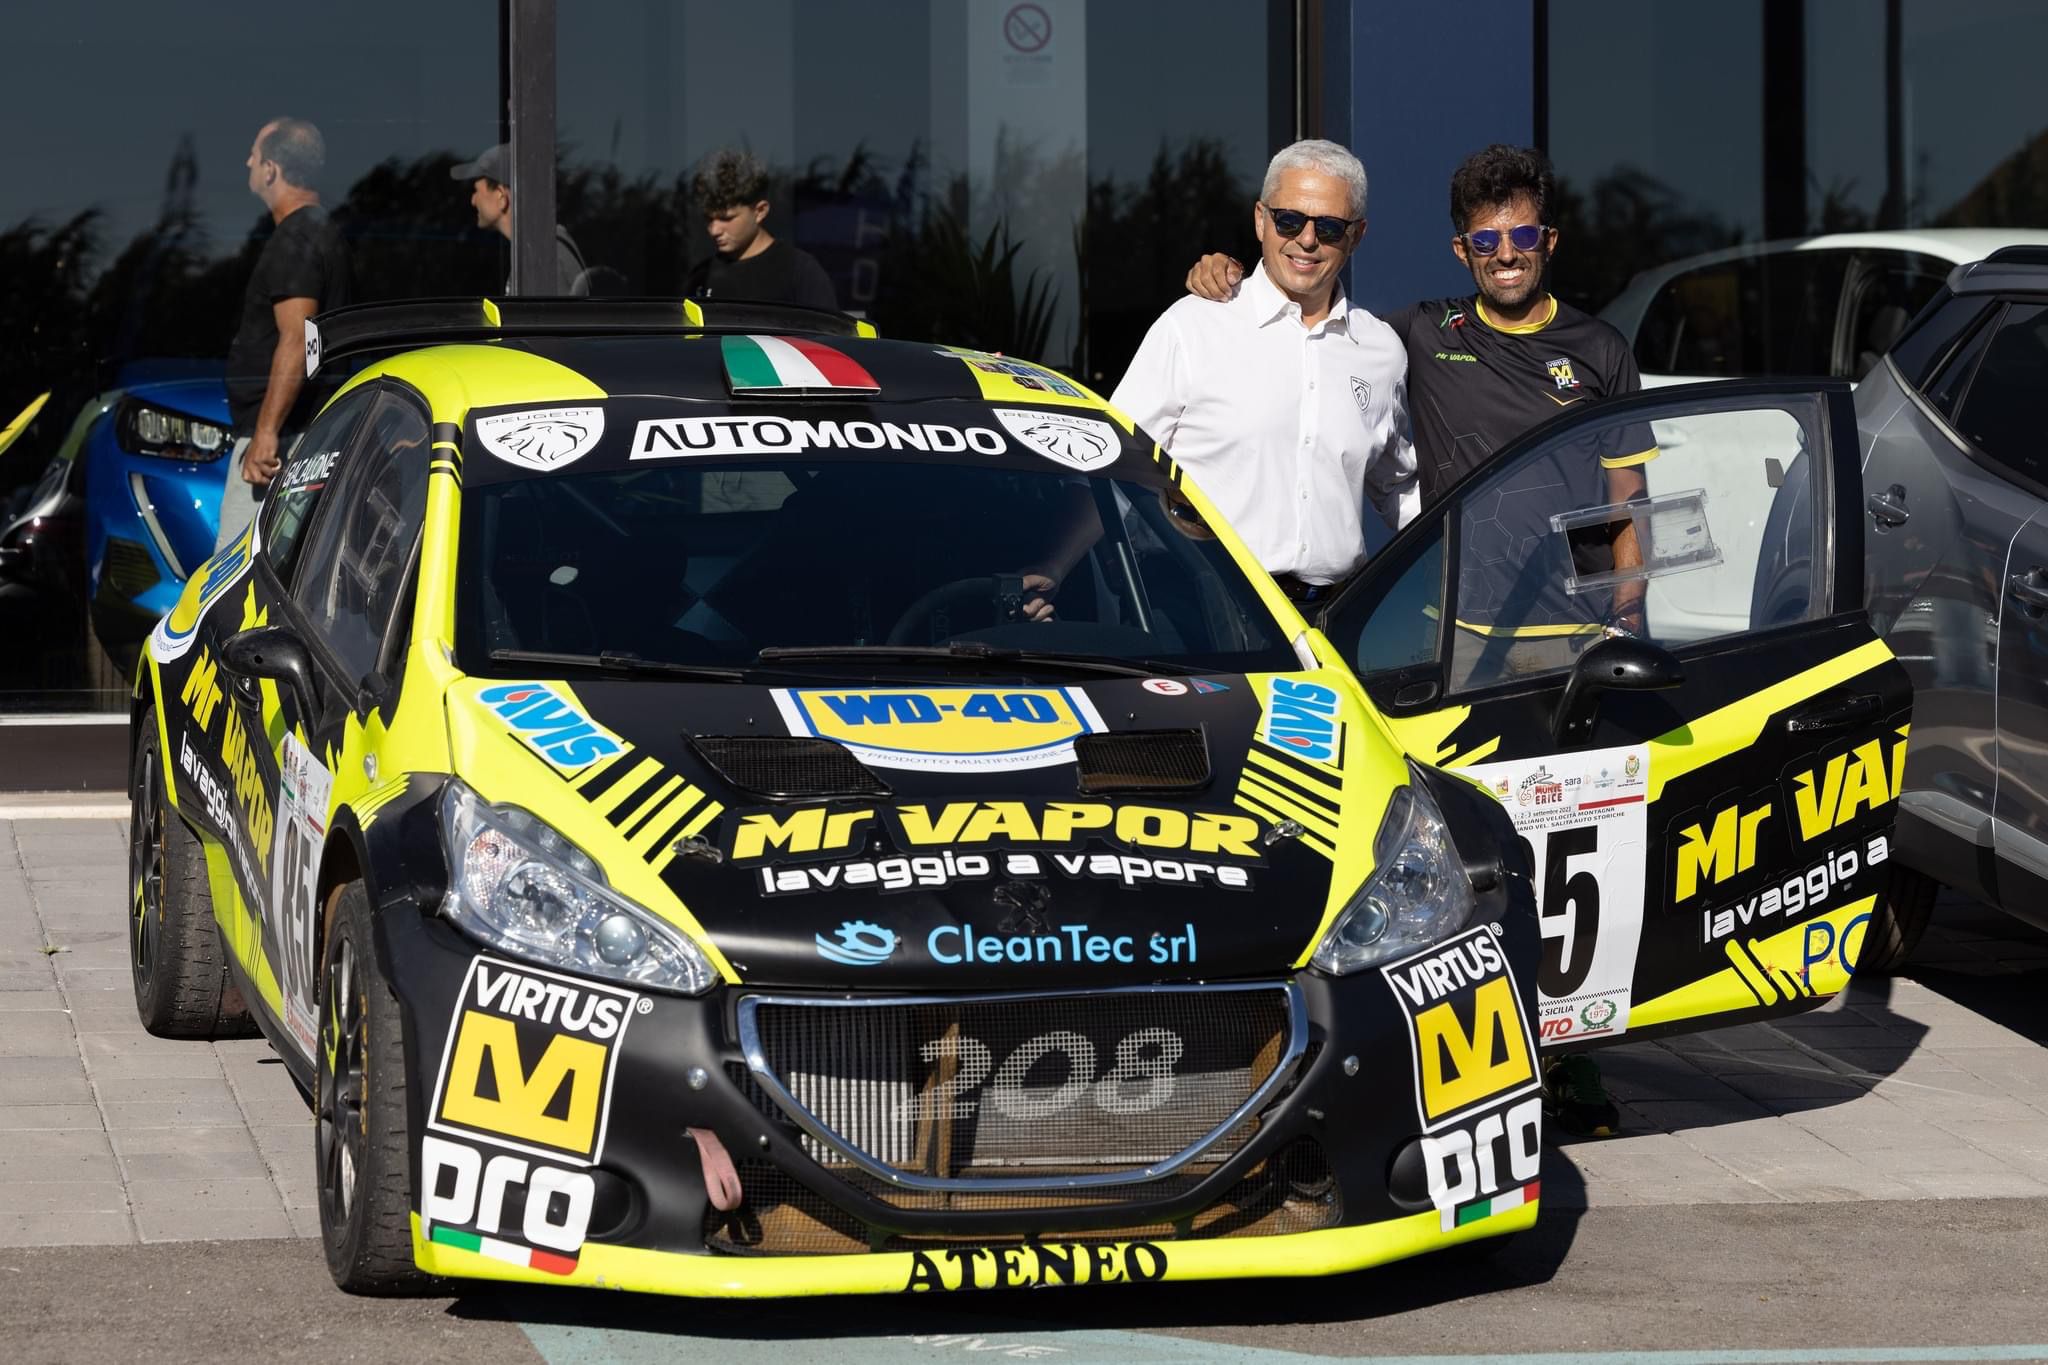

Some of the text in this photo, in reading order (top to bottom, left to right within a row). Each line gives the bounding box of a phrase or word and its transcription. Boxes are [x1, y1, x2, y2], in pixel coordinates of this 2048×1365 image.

[485, 410, 593, 425] PEUGEOT
[643, 420, 1007, 456] AUTOMONDO
[1003, 411, 1101, 428] PEUGEOT
[479, 683, 621, 766] AVIS
[821, 693, 1060, 726] WD-40
[1268, 678, 1337, 760] AVIS
[181, 643, 273, 880] Mr VAPOR
[867, 750, 1060, 765] PRODOTTO MULTIFUNZIONE
[1535, 783, 1562, 795] MONTE
[1535, 793, 1562, 805] ERICE
[1564, 776, 1582, 786] sara
[732, 802, 1261, 860] Mr VAPOR
[1532, 808, 1559, 818] settembre
[1559, 806, 1572, 814] 2023
[1551, 819, 1573, 828] SALITA
[1573, 817, 1592, 825] AUTO
[1593, 811, 1625, 821] STORICHE
[1577, 807, 1615, 817] MONTAGNA
[762, 850, 1249, 893] lavaggio a vapore
[1675, 802, 1771, 903] Mr
[1704, 836, 1889, 943] lavaggio a
[281, 815, 315, 1015] 85
[1517, 825, 1600, 998] 5
[927, 923, 1197, 964] CleanTec srl
[1391, 935, 1502, 1007] VIRTUS
[476, 965, 623, 1039] VIRTUS
[1544, 1005, 1574, 1017] SICILIA
[1588, 1008, 1610, 1020] 1975
[896, 1027, 1184, 1121] 208
[1420, 1098, 1543, 1233] pro
[421, 1134, 596, 1252] pro
[906, 1242, 1168, 1292] ATENEO
